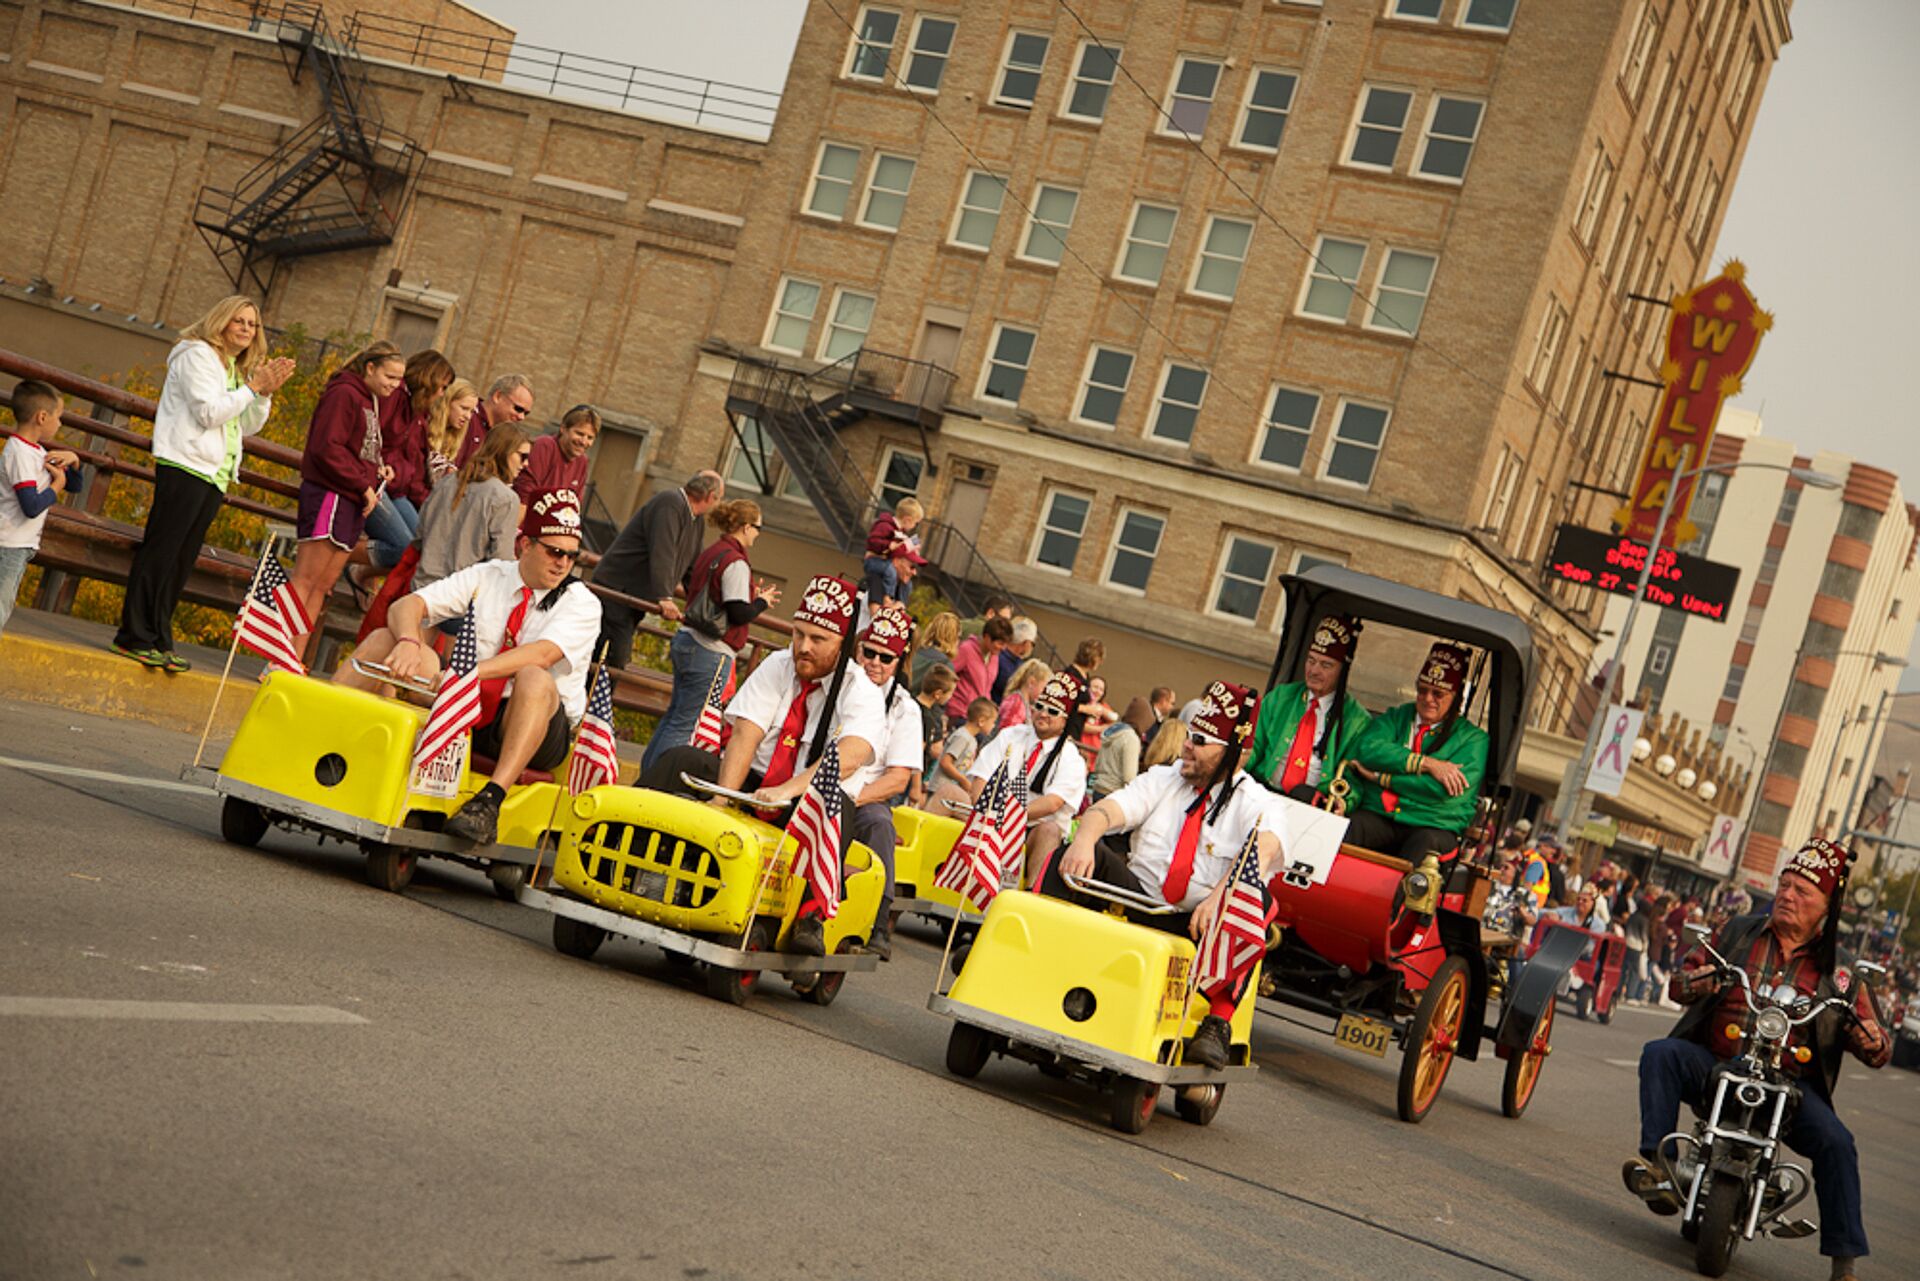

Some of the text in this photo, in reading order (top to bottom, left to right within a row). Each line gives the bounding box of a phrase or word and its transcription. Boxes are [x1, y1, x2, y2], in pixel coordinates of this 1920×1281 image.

[1640, 314, 1737, 515] WILMA
[1606, 548, 1682, 581] Shpogle
[1619, 539, 1678, 566] Sep 26
[802, 577, 855, 618] AGDAD
[1598, 572, 1621, 590] 27
[1647, 584, 1675, 605] The
[1681, 594, 1724, 618] Used
[873, 608, 910, 640] AGDAD
[1341, 1025, 1384, 1050] 1901
